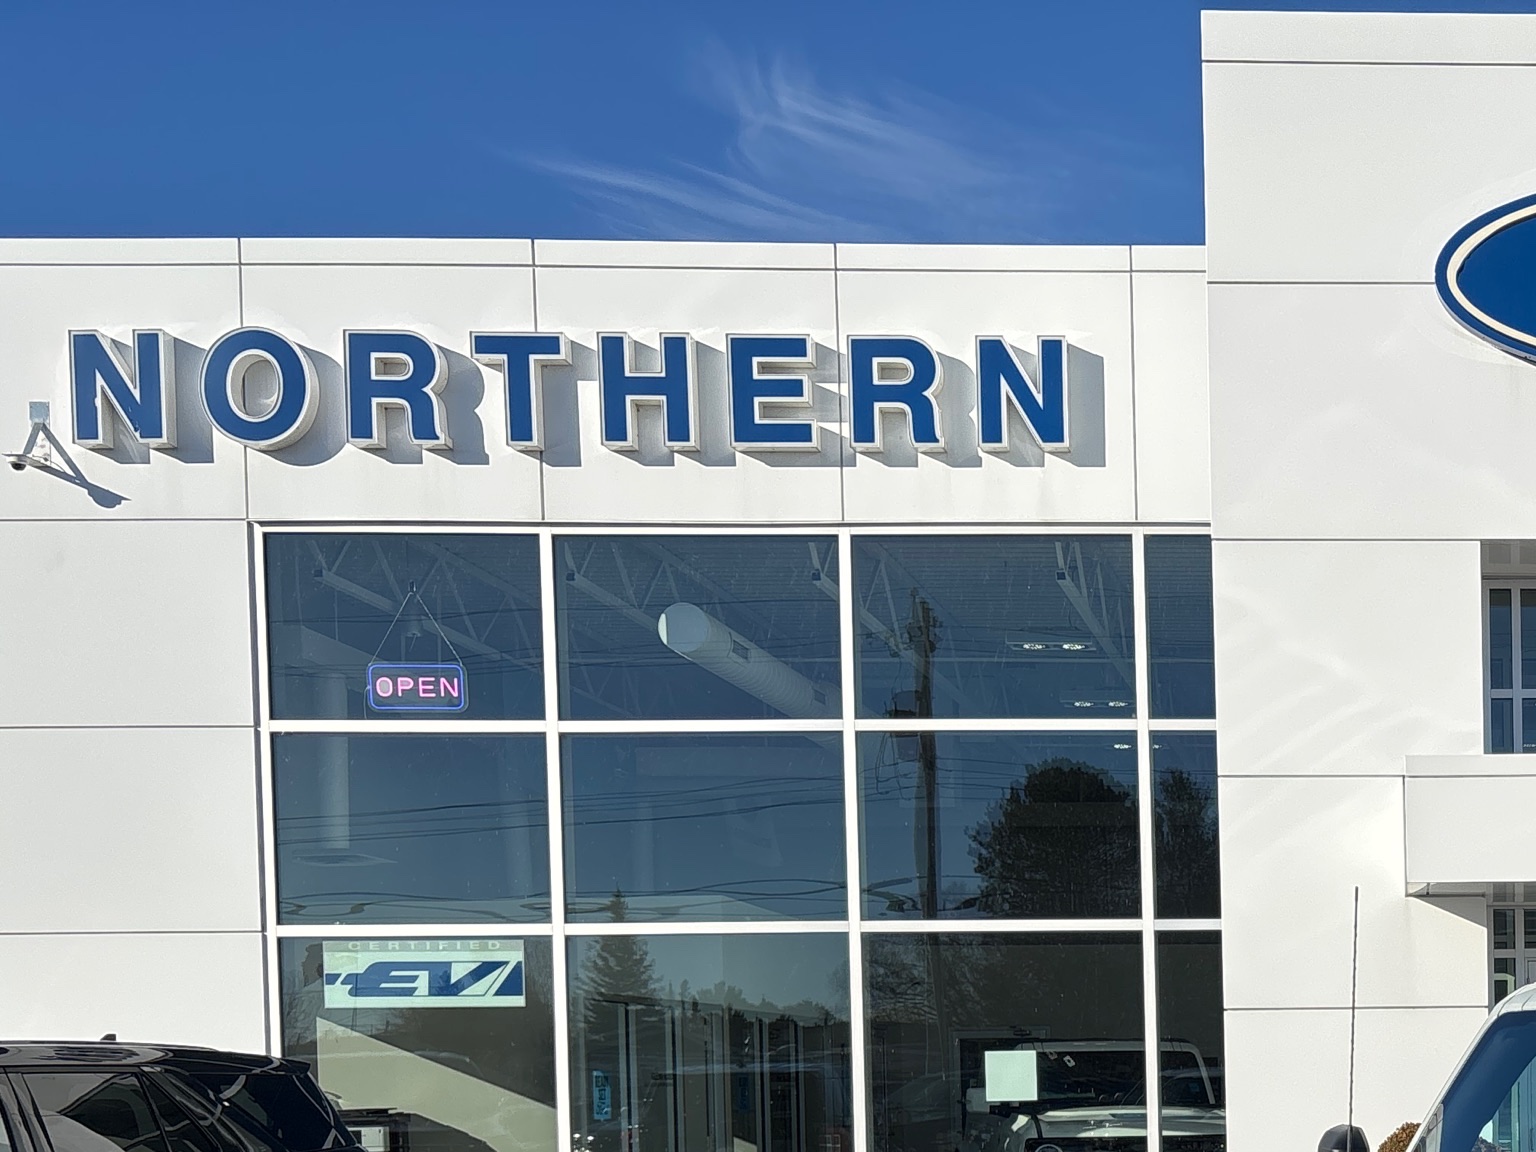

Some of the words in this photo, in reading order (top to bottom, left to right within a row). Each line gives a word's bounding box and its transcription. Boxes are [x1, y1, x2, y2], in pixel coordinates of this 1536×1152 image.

[68, 326, 1069, 451] NORTHERN
[375, 676, 459, 698] OPEN
[347, 940, 501, 950] CERTIFIED
